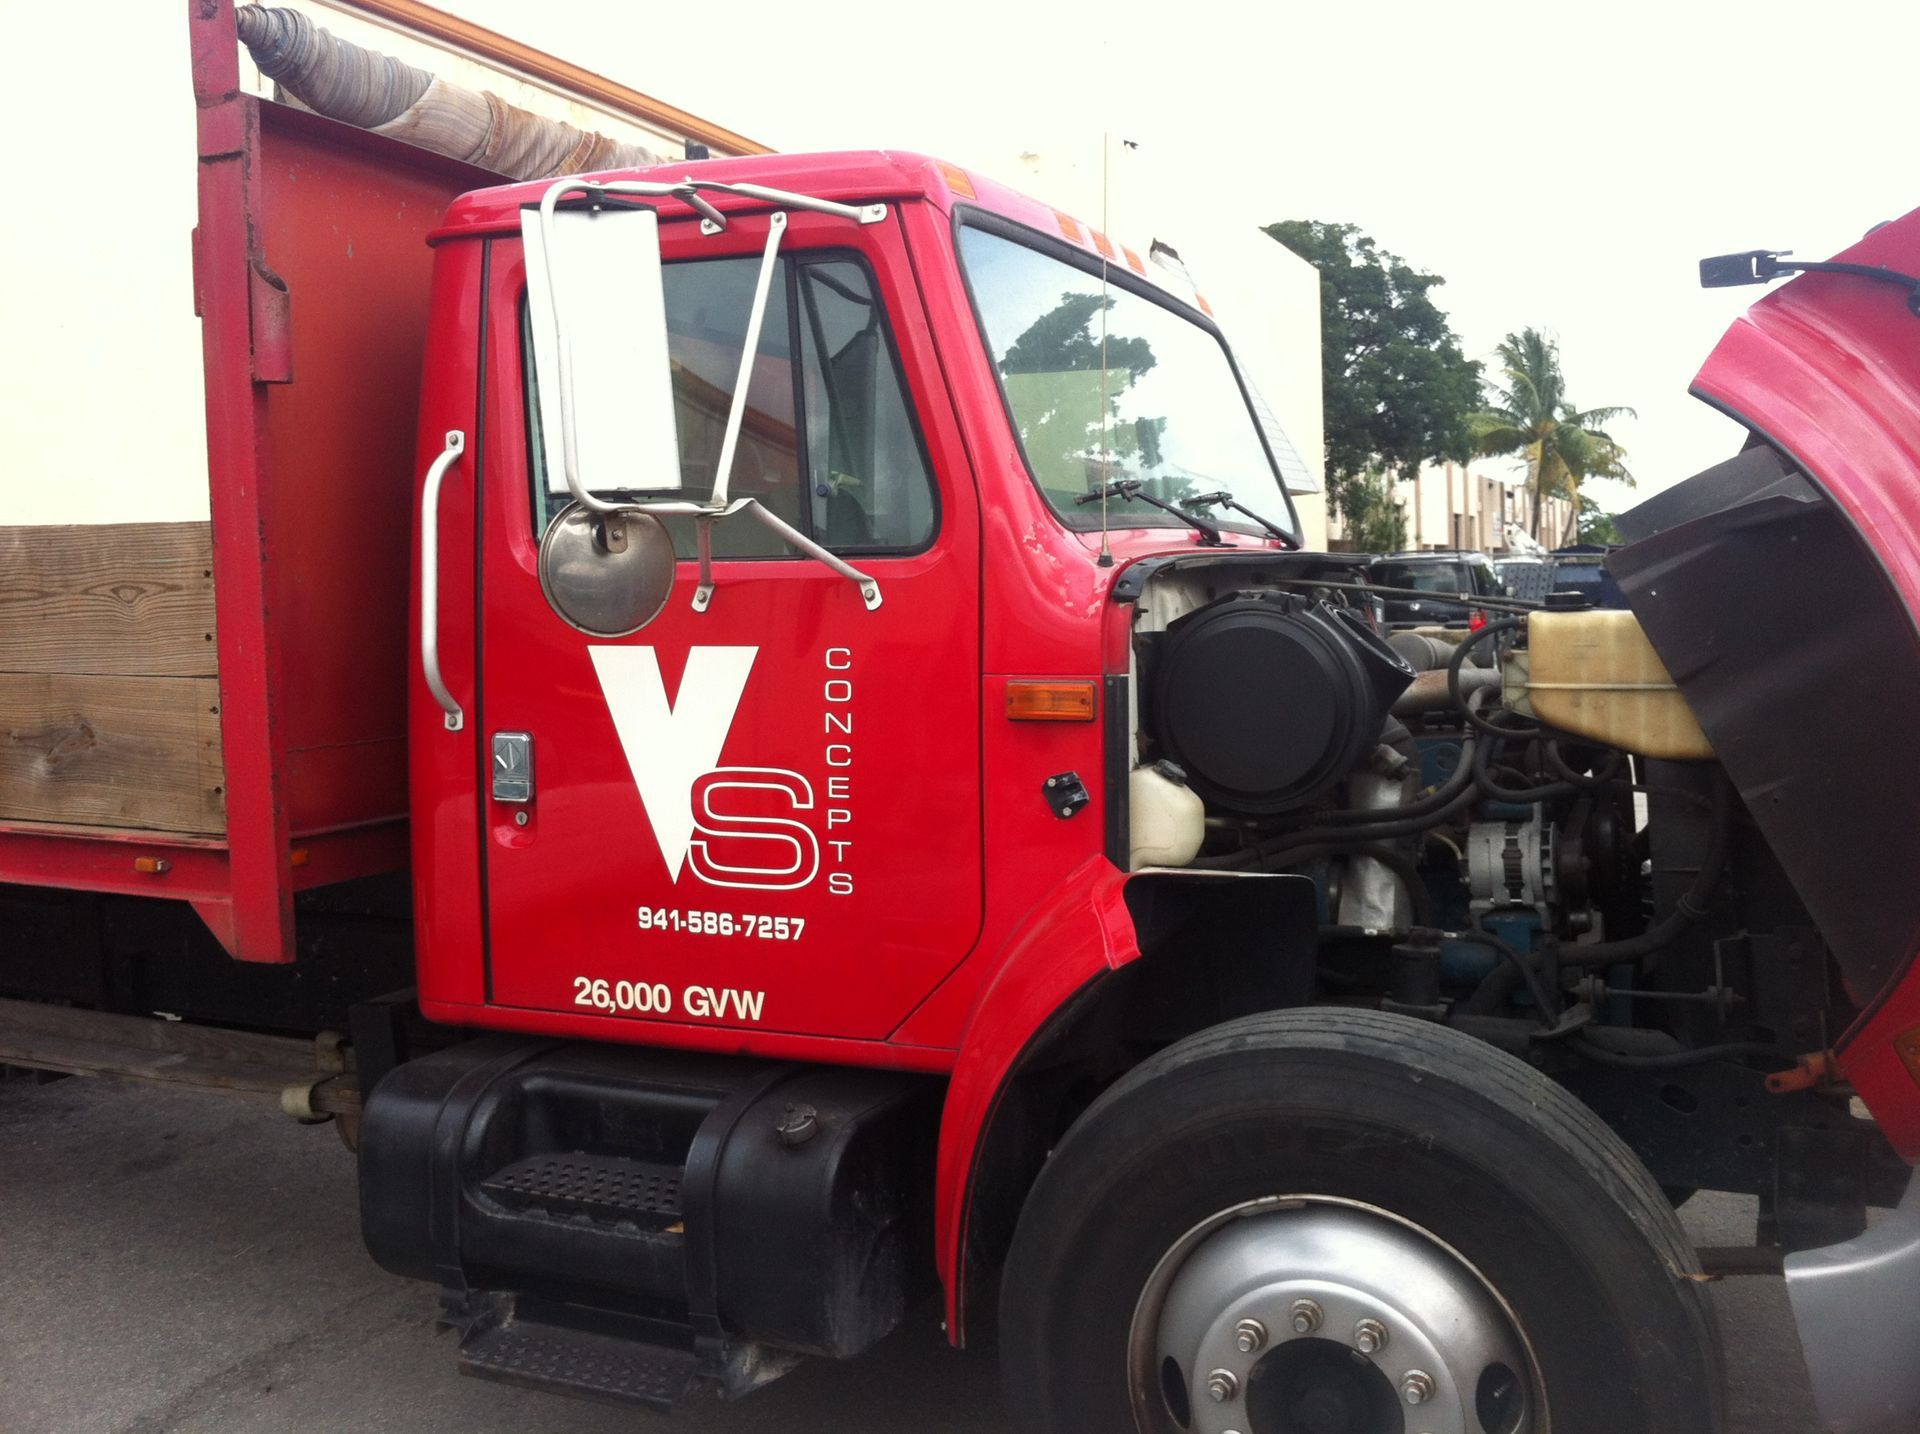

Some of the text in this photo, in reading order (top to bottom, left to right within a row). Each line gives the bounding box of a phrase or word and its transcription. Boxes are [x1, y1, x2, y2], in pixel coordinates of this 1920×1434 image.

[824, 647, 854, 895] CONCEPTS
[638, 906, 806, 941] 941-586-7257
[573, 976, 765, 1021] 26,000 GVW
